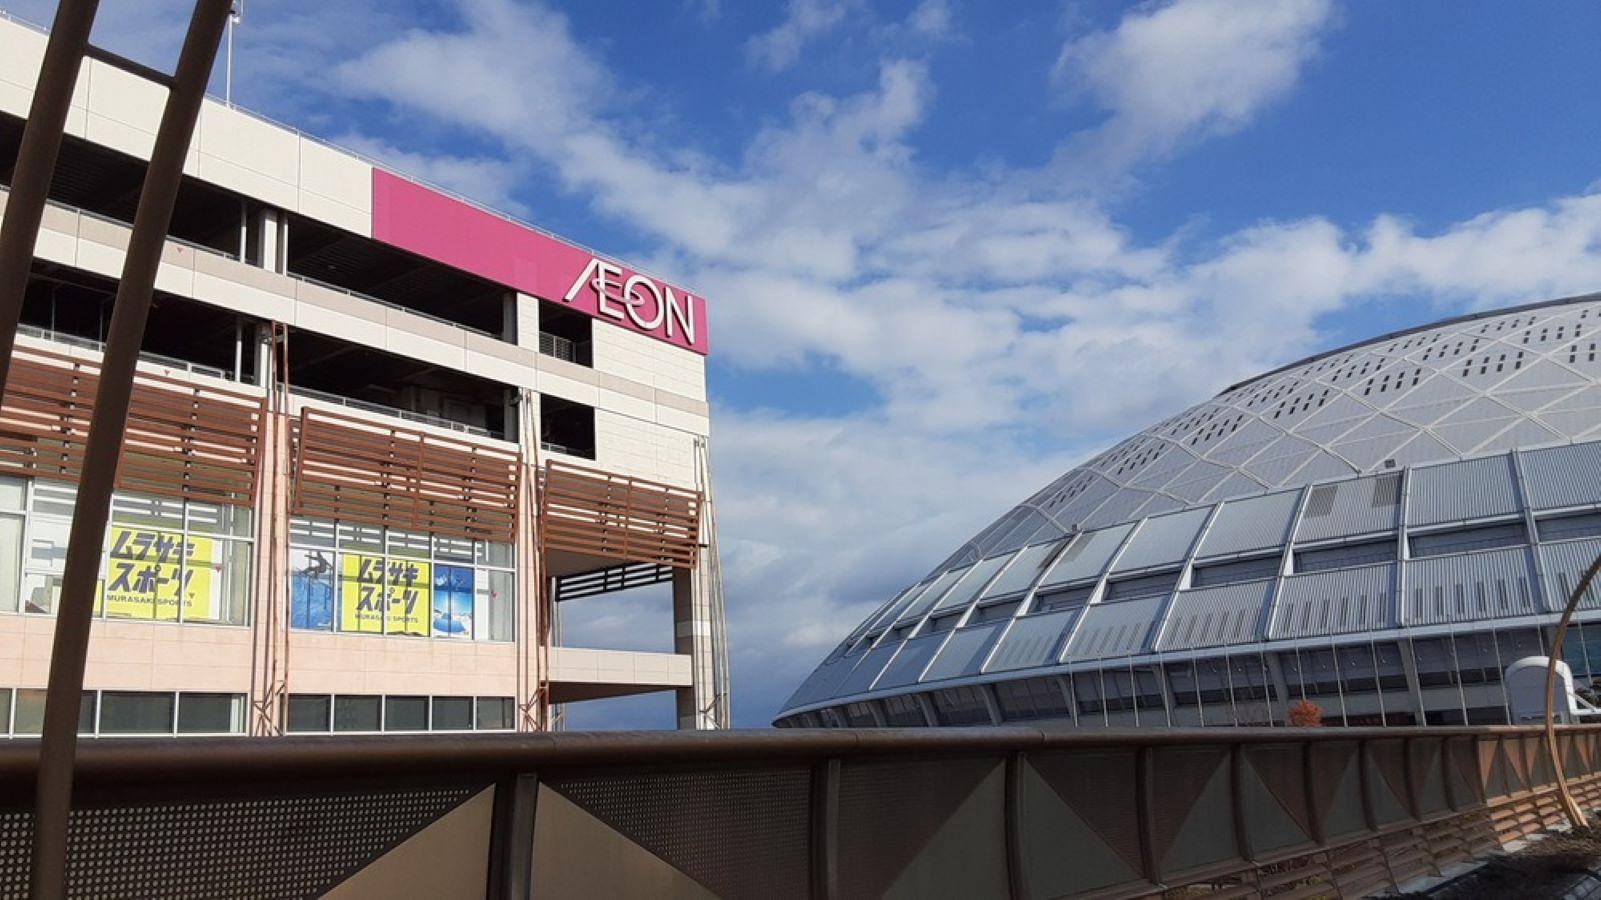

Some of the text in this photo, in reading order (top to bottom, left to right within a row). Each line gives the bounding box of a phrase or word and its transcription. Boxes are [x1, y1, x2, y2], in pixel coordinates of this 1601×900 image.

[110, 530, 196, 564] ムラサキ
[107, 562, 194, 597] スポーツ
[357, 559, 419, 587] ムラサキ
[356, 586, 419, 615] スポーツ
